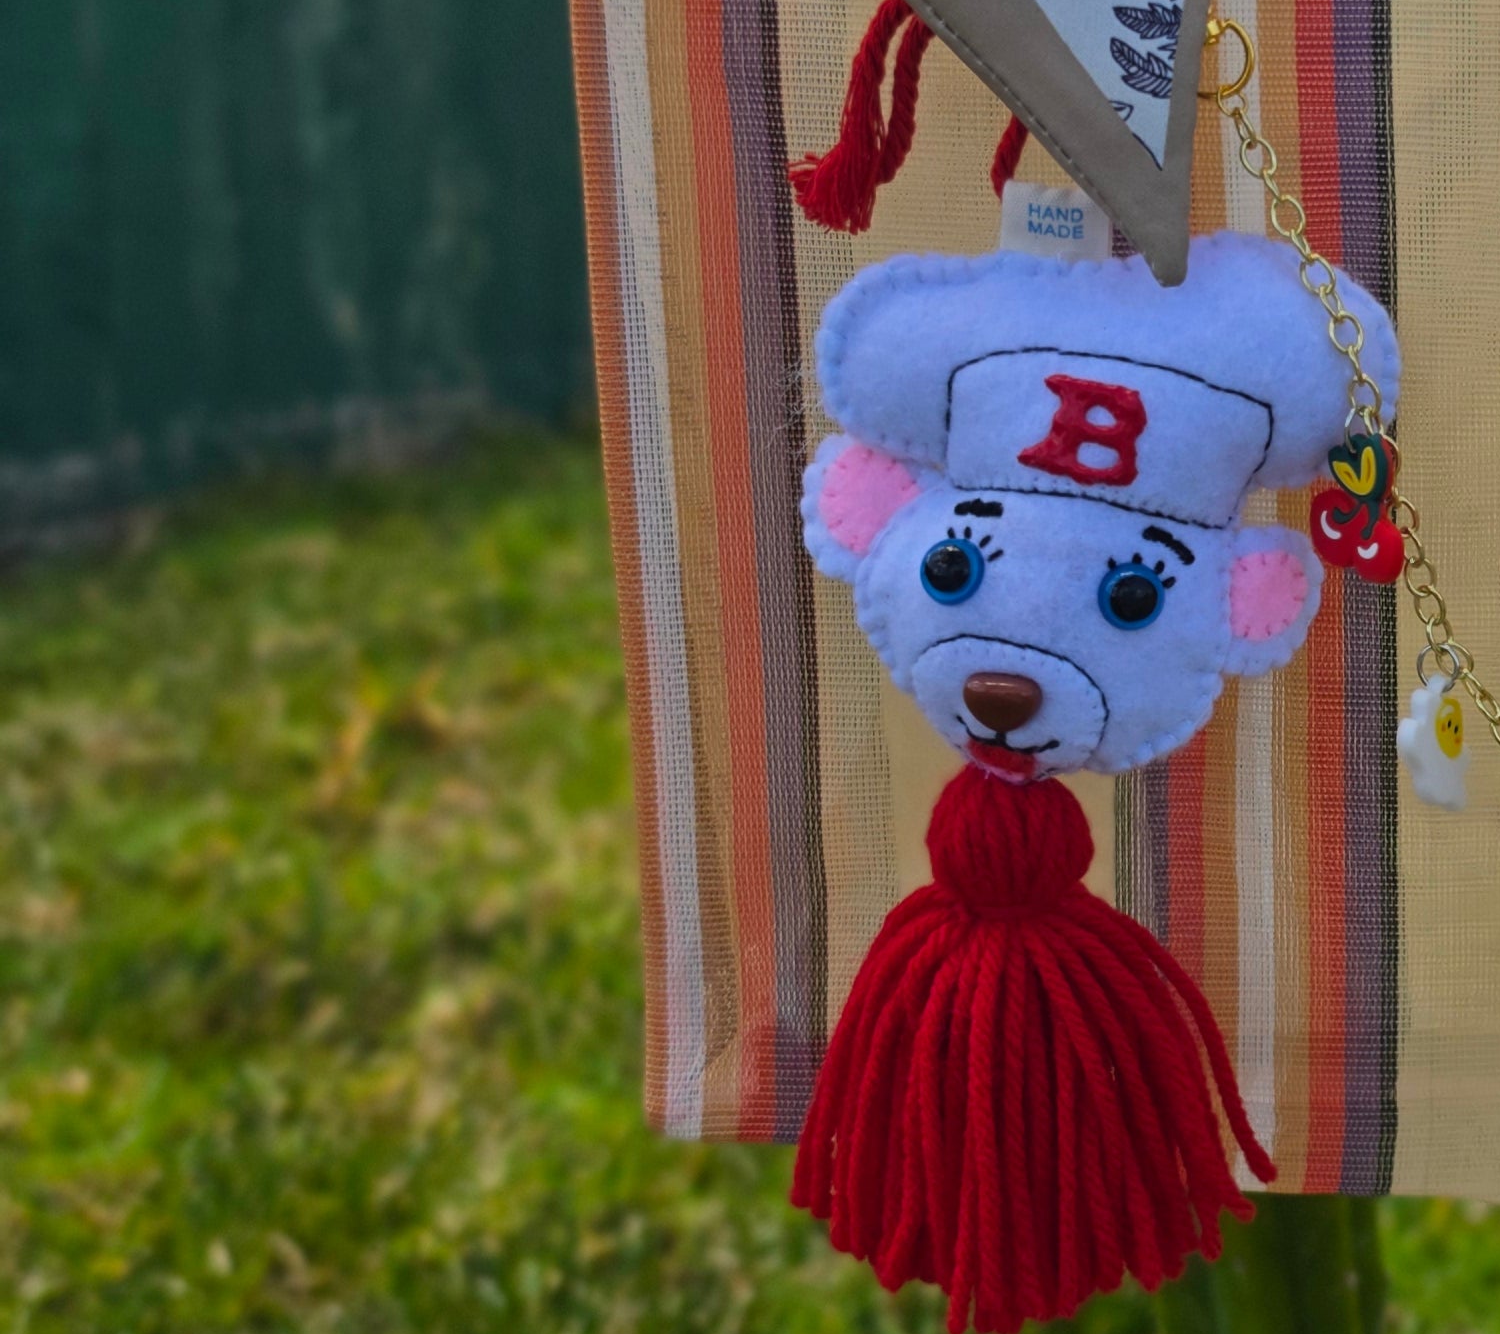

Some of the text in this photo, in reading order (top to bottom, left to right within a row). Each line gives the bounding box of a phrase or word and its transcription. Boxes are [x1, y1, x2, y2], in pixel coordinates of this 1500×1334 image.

[1028, 203, 1084, 223] HAND
[1027, 220, 1085, 240] MADE
[1016, 373, 1148, 487] B
